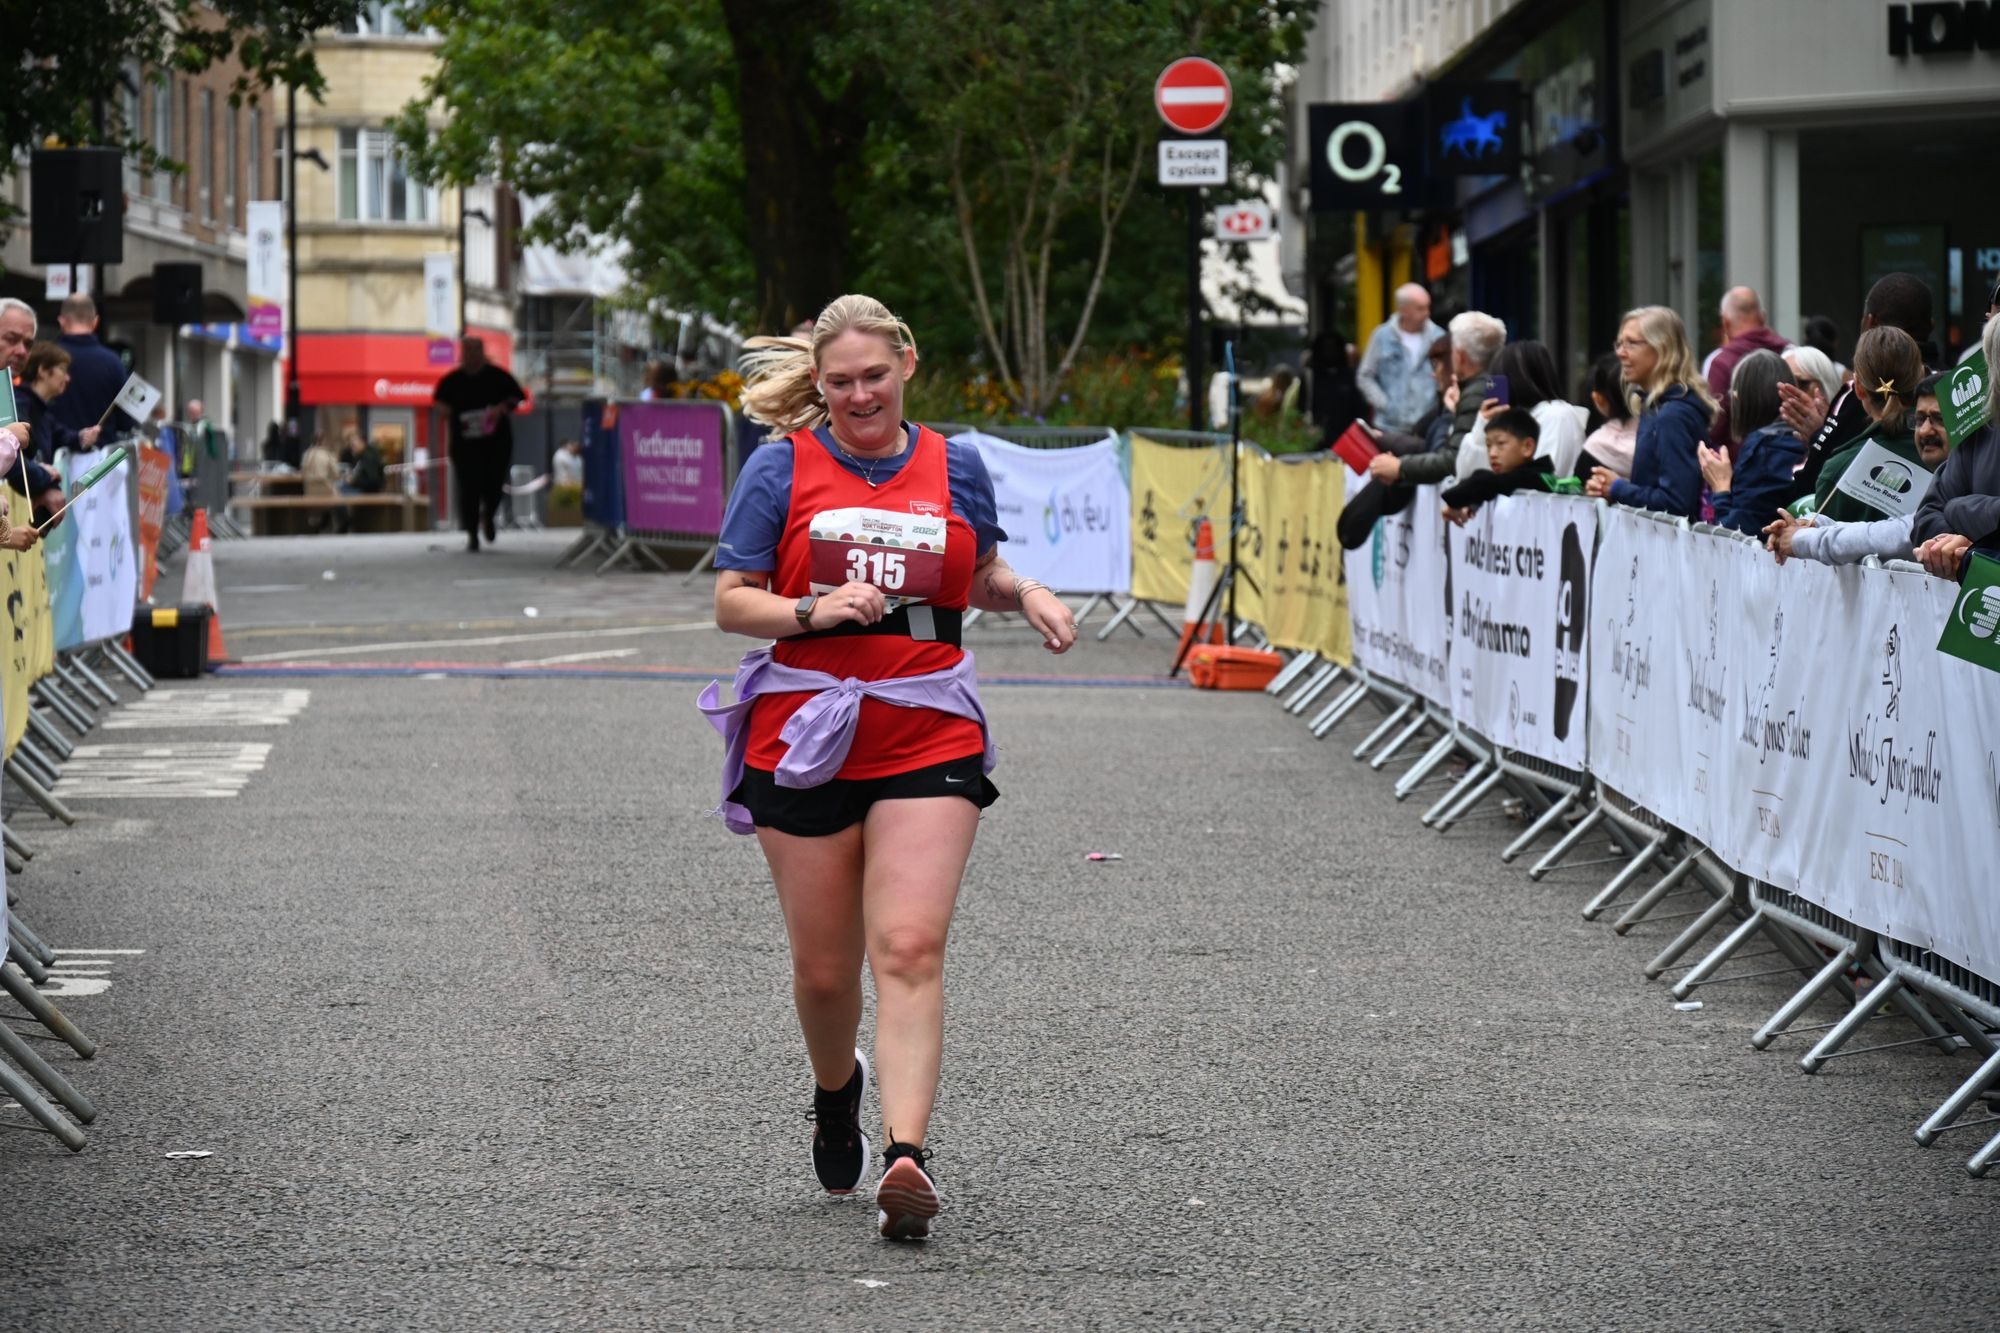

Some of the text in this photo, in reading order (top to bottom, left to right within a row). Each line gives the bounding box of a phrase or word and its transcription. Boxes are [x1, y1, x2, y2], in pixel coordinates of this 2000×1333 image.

[1166, 146, 1220, 161] Except
[1167, 162, 1217, 179] cycles
[1862, 479, 1882, 493] NLive
[1882, 488, 1902, 504] Radio
[845, 548, 906, 591] 315
